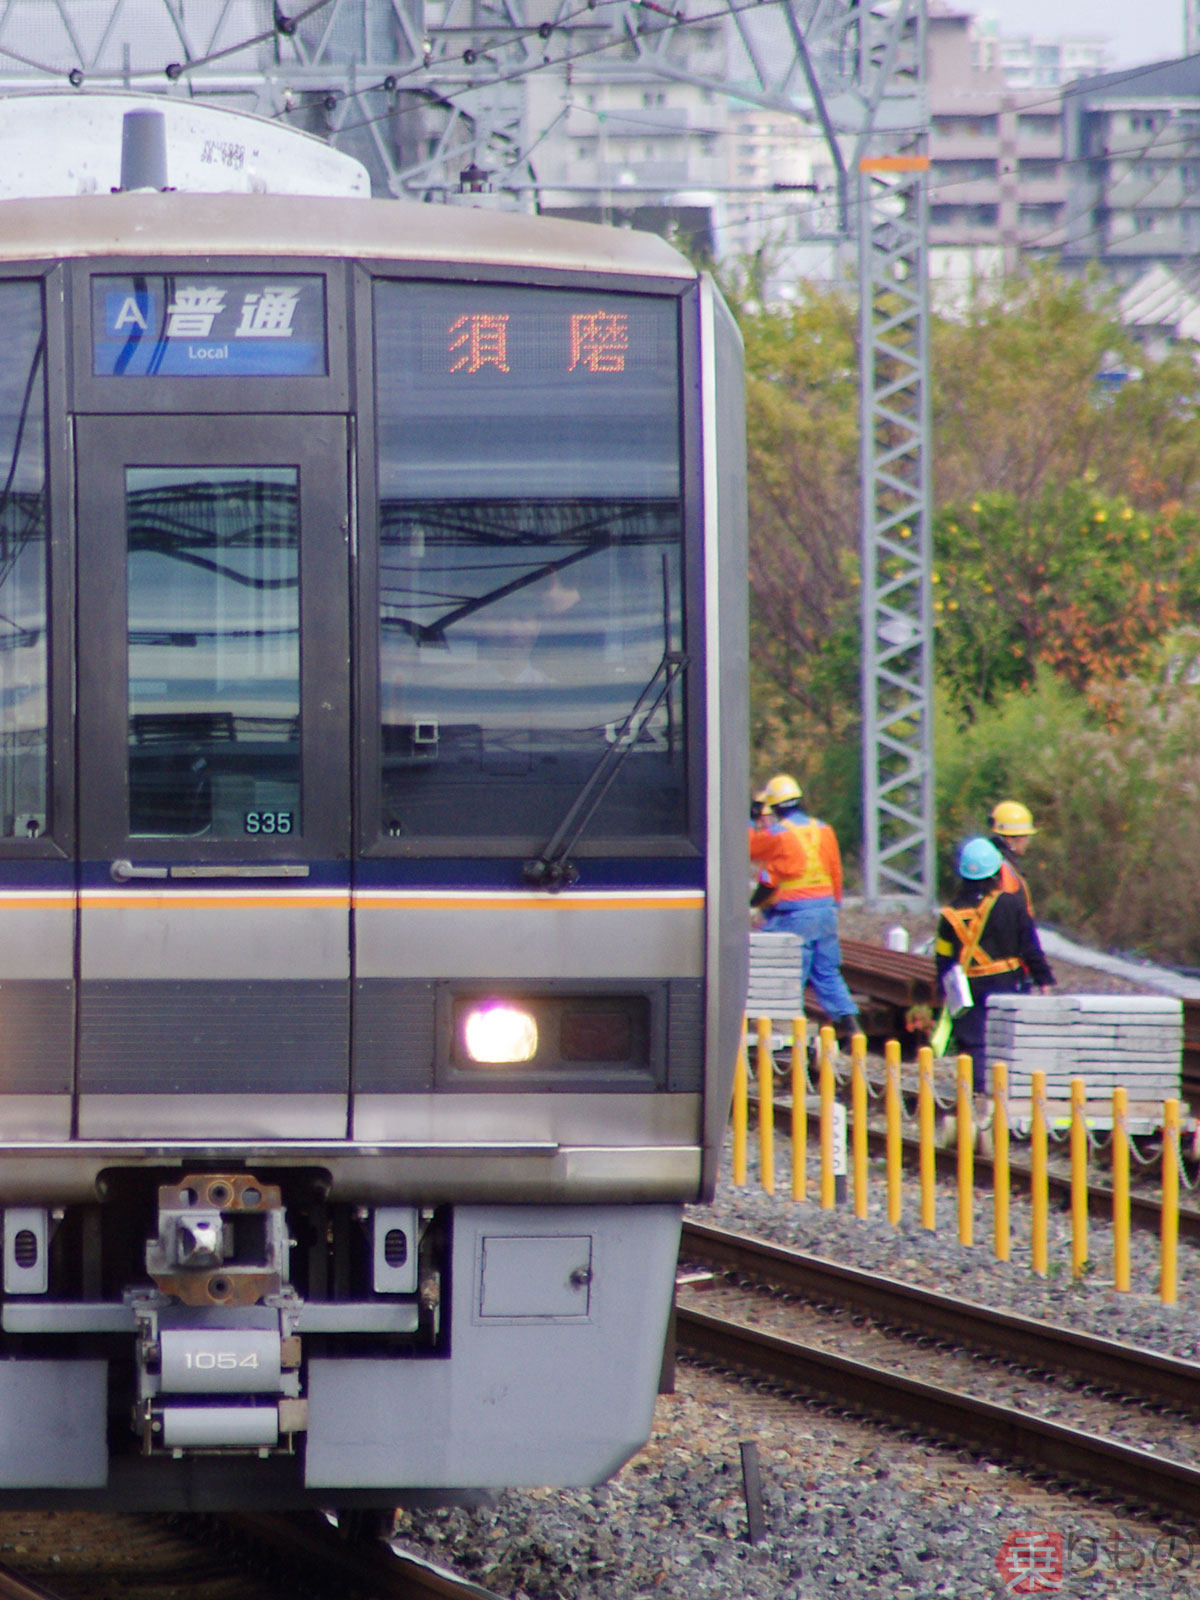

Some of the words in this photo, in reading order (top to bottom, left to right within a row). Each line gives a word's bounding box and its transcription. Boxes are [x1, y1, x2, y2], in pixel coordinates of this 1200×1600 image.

[114, 297, 147, 329] A
[167, 286, 301, 337] 普通
[188, 346, 229, 359] Local
[449, 311, 629, 373] 須磨
[246, 812, 291, 833] S35
[185, 1352, 259, 1369] 1054
